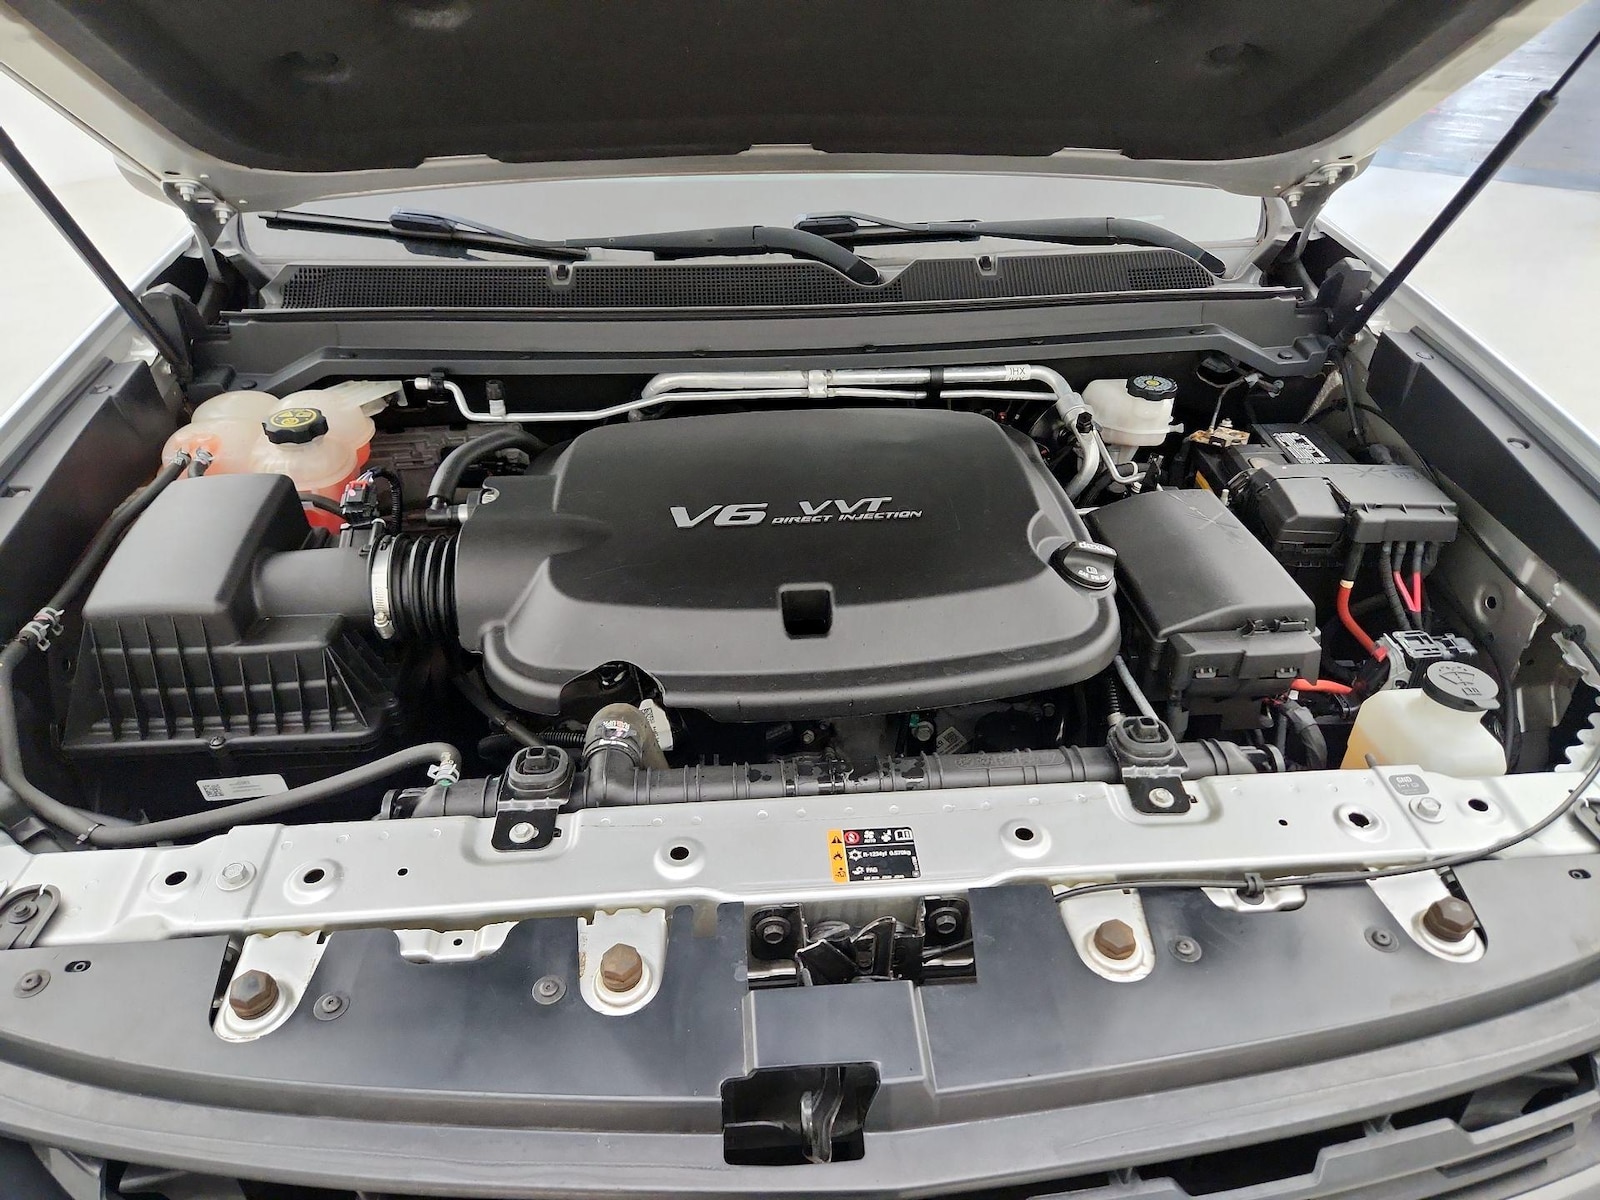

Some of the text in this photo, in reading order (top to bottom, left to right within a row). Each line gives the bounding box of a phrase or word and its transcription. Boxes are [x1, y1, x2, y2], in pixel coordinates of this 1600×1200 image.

[799, 496, 892, 515] VVT
[669, 502, 769, 529] V6
[771, 510, 923, 525] DIRECT INJECTION
